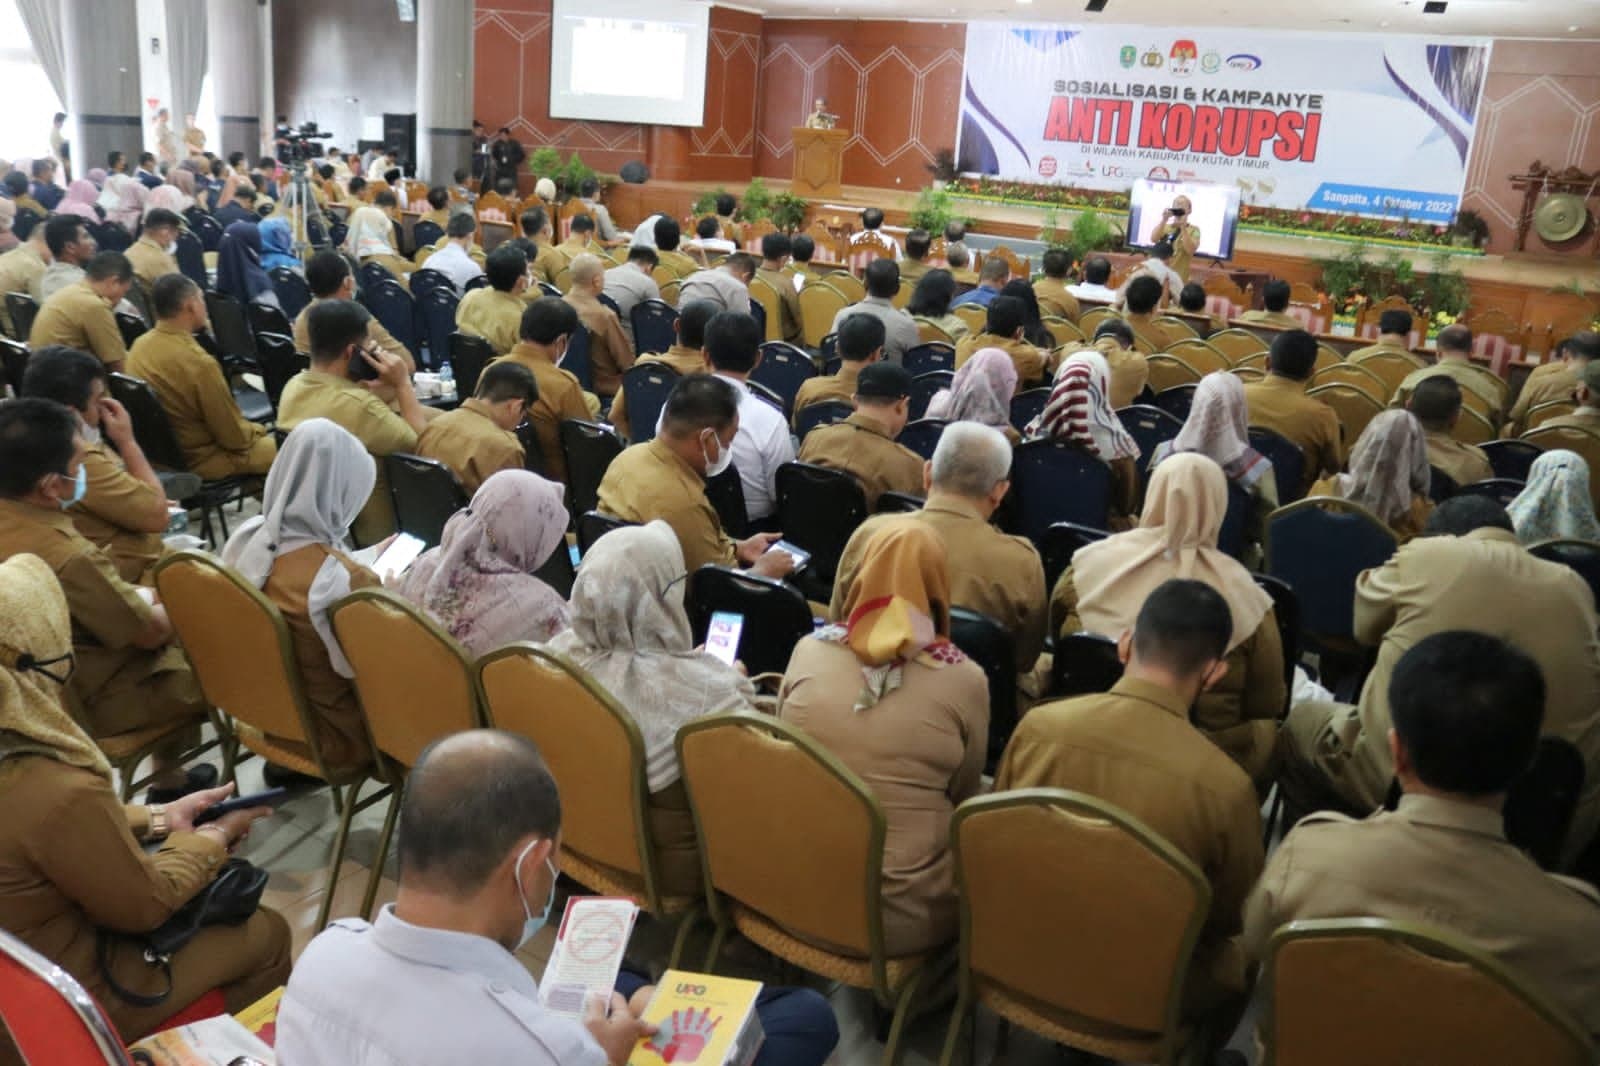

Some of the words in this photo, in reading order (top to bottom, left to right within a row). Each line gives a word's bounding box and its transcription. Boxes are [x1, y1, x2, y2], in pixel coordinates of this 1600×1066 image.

[1054, 80, 1178, 100] SOSIALISASI
[1183, 87, 1197, 100] &
[1202, 87, 1323, 109] KAMPANYE
[1043, 96, 1134, 147] ANTI
[1137, 101, 1322, 163] KORUPSI
[1093, 147, 1136, 157] WILAYAH
[1137, 149, 1200, 164] KABUPATEN
[1202, 155, 1234, 166] KUTAI
[1237, 159, 1270, 169] TIMUR
[1323, 189, 1370, 207] Sangatta,
[1373, 195, 1381, 207] 4
[1425, 200, 1453, 213] 2022
